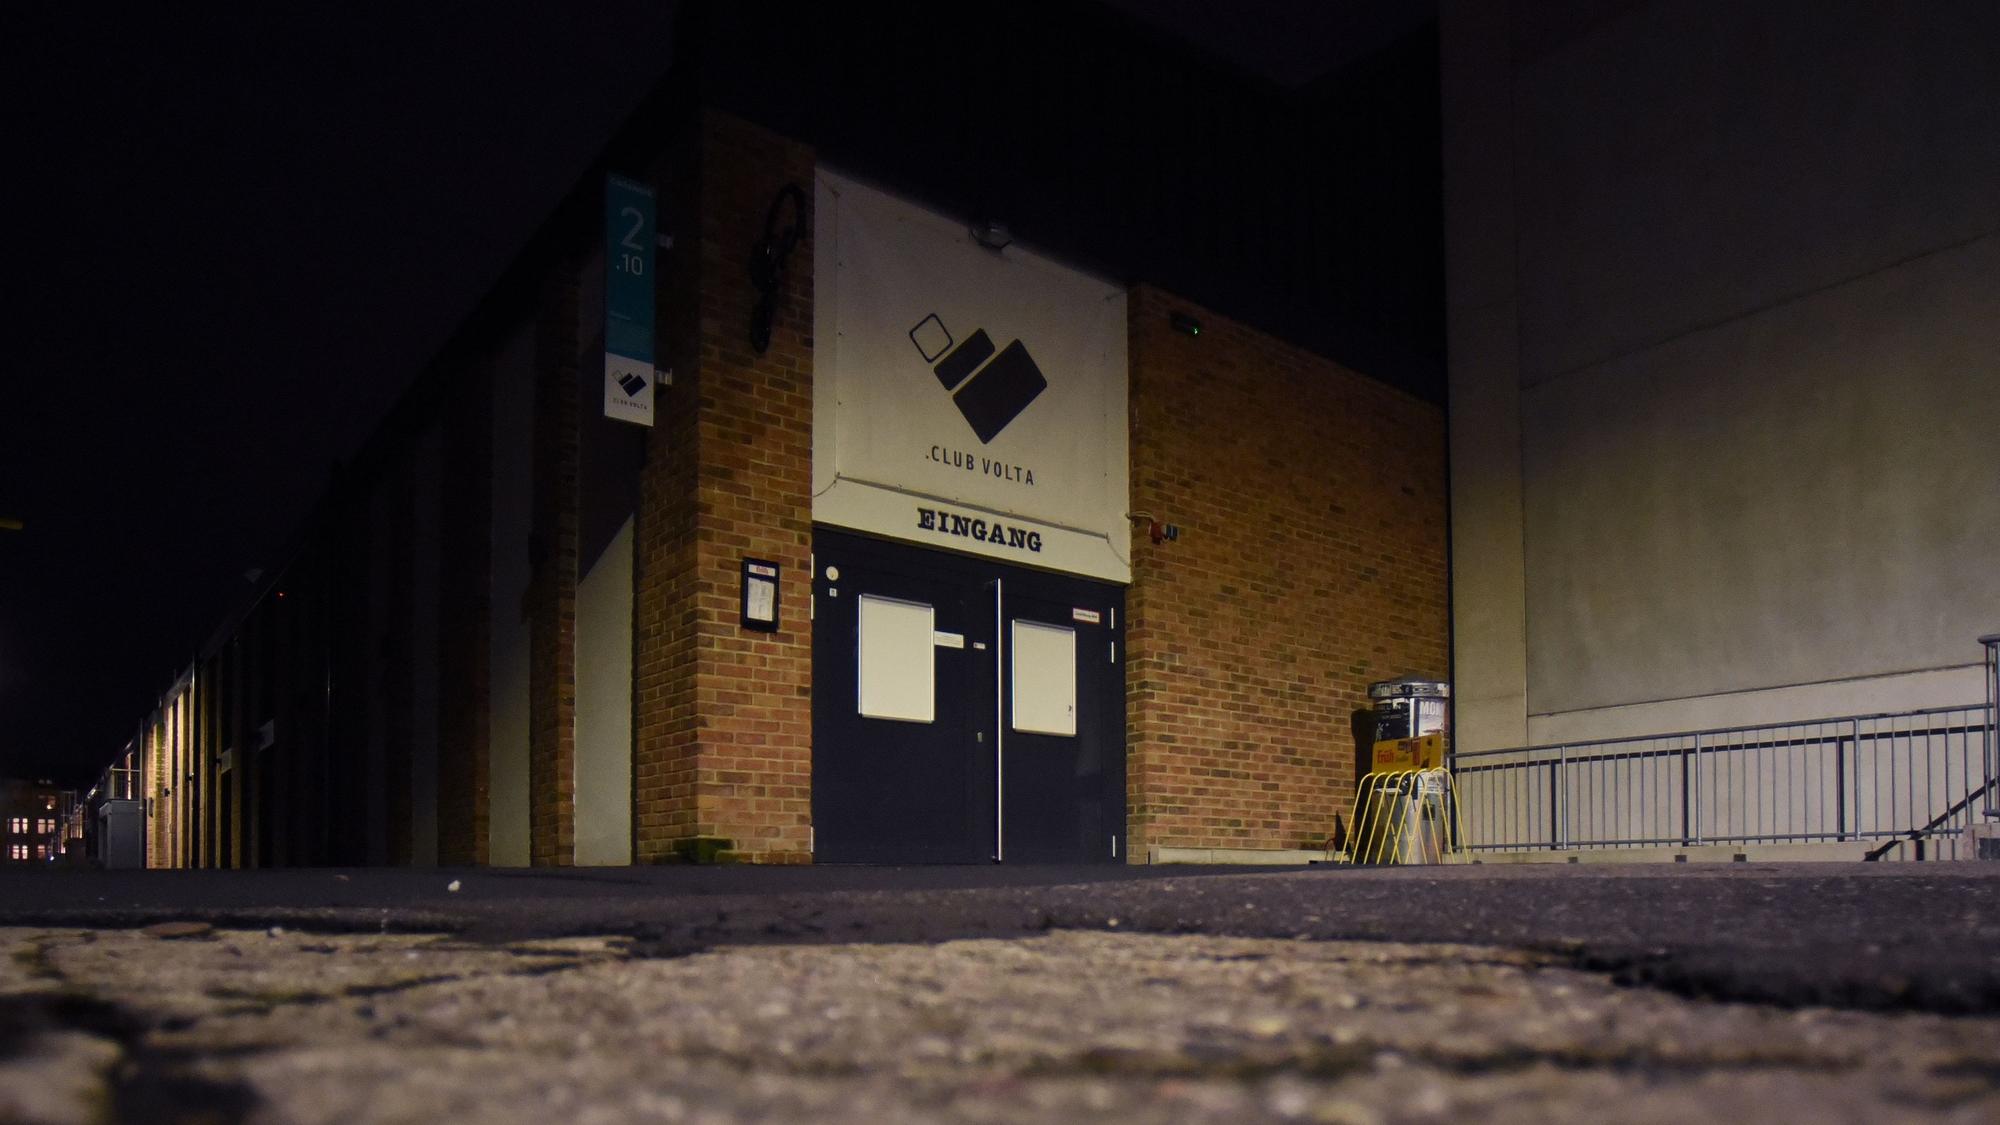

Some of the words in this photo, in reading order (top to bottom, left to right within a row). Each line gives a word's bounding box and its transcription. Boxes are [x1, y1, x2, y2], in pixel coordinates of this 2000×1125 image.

[621, 206, 644, 251] 2
[982, 457, 1034, 485] VOLTA
[917, 507, 1042, 552] EINGANG
